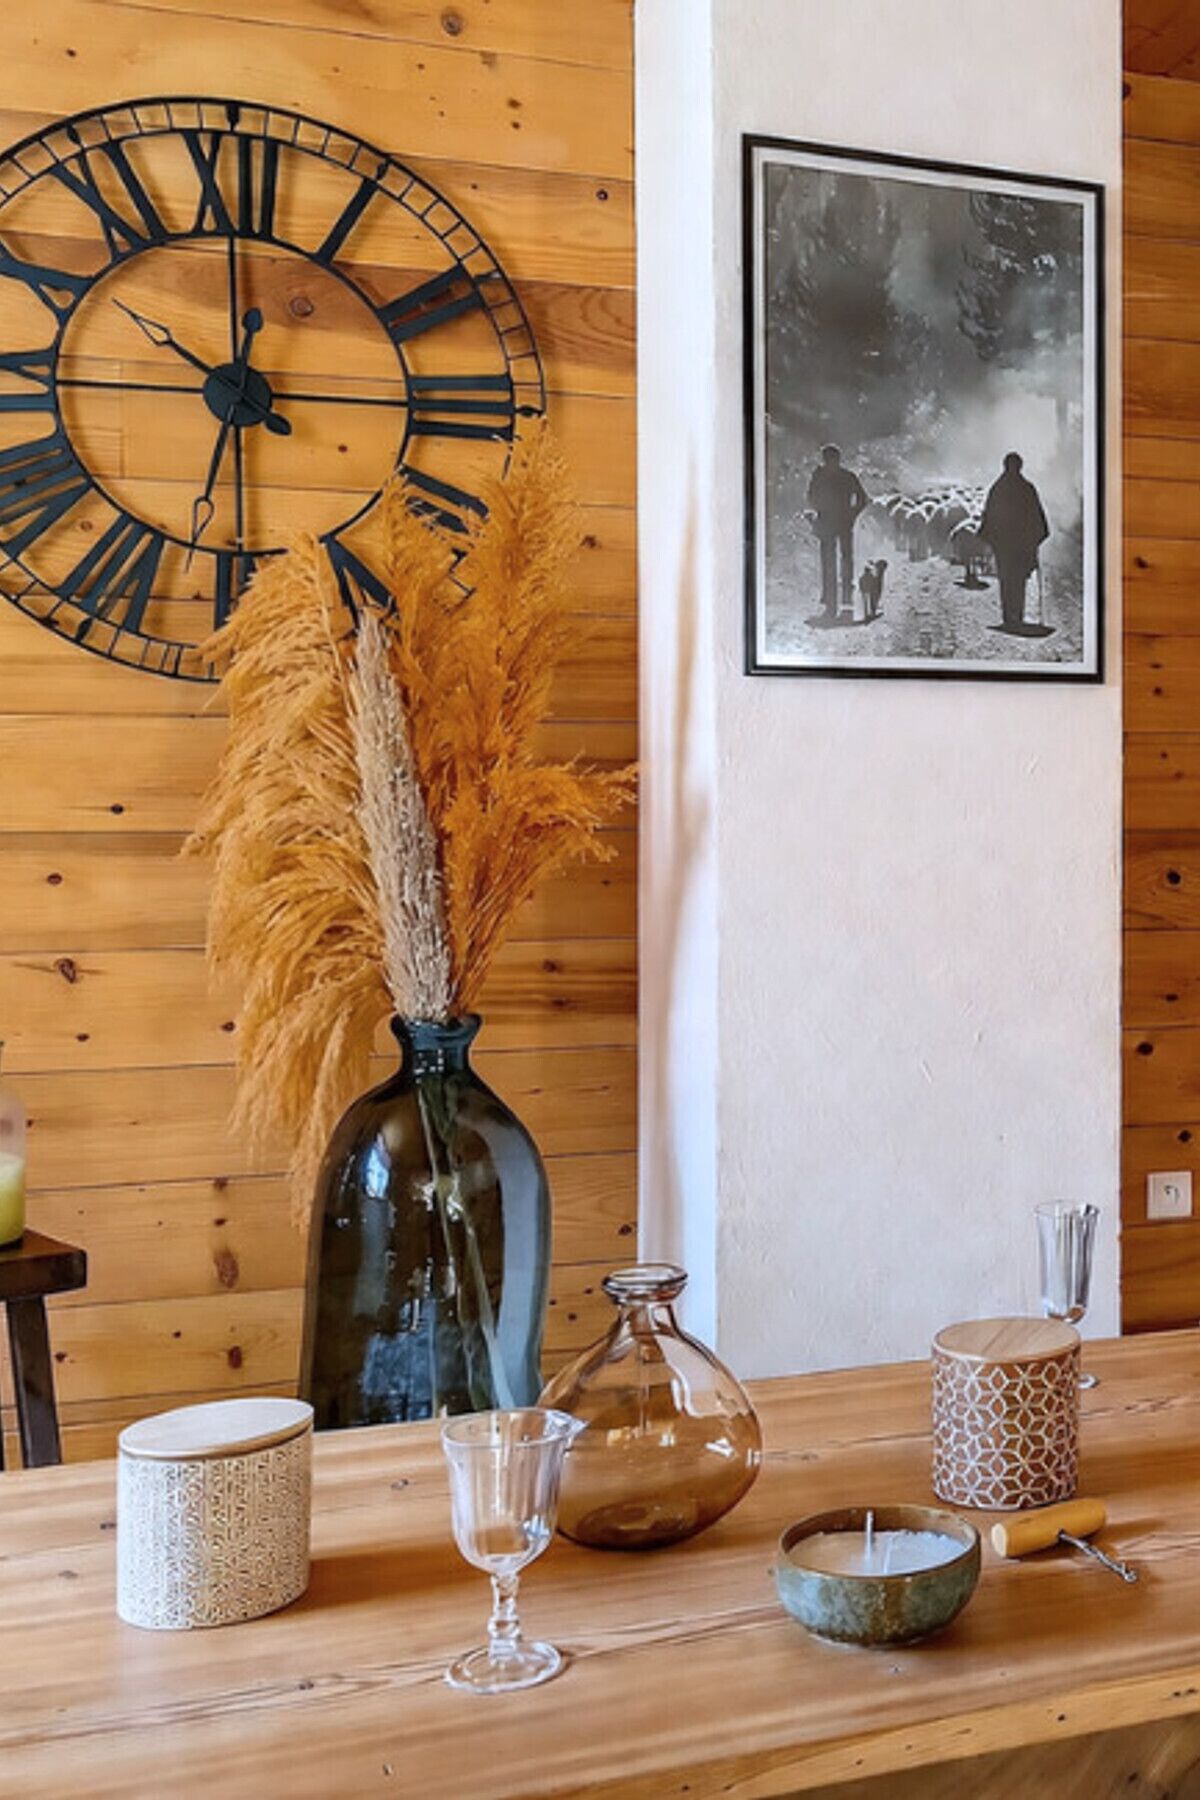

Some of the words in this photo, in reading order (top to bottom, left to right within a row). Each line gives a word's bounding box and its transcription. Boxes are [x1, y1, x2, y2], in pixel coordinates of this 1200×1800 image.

[50, 138, 168, 260] XI
[180, 129, 279, 238] XII
[313, 178, 378, 265] I
[376, 262, 484, 343] II
[406, 374, 515, 441] III
